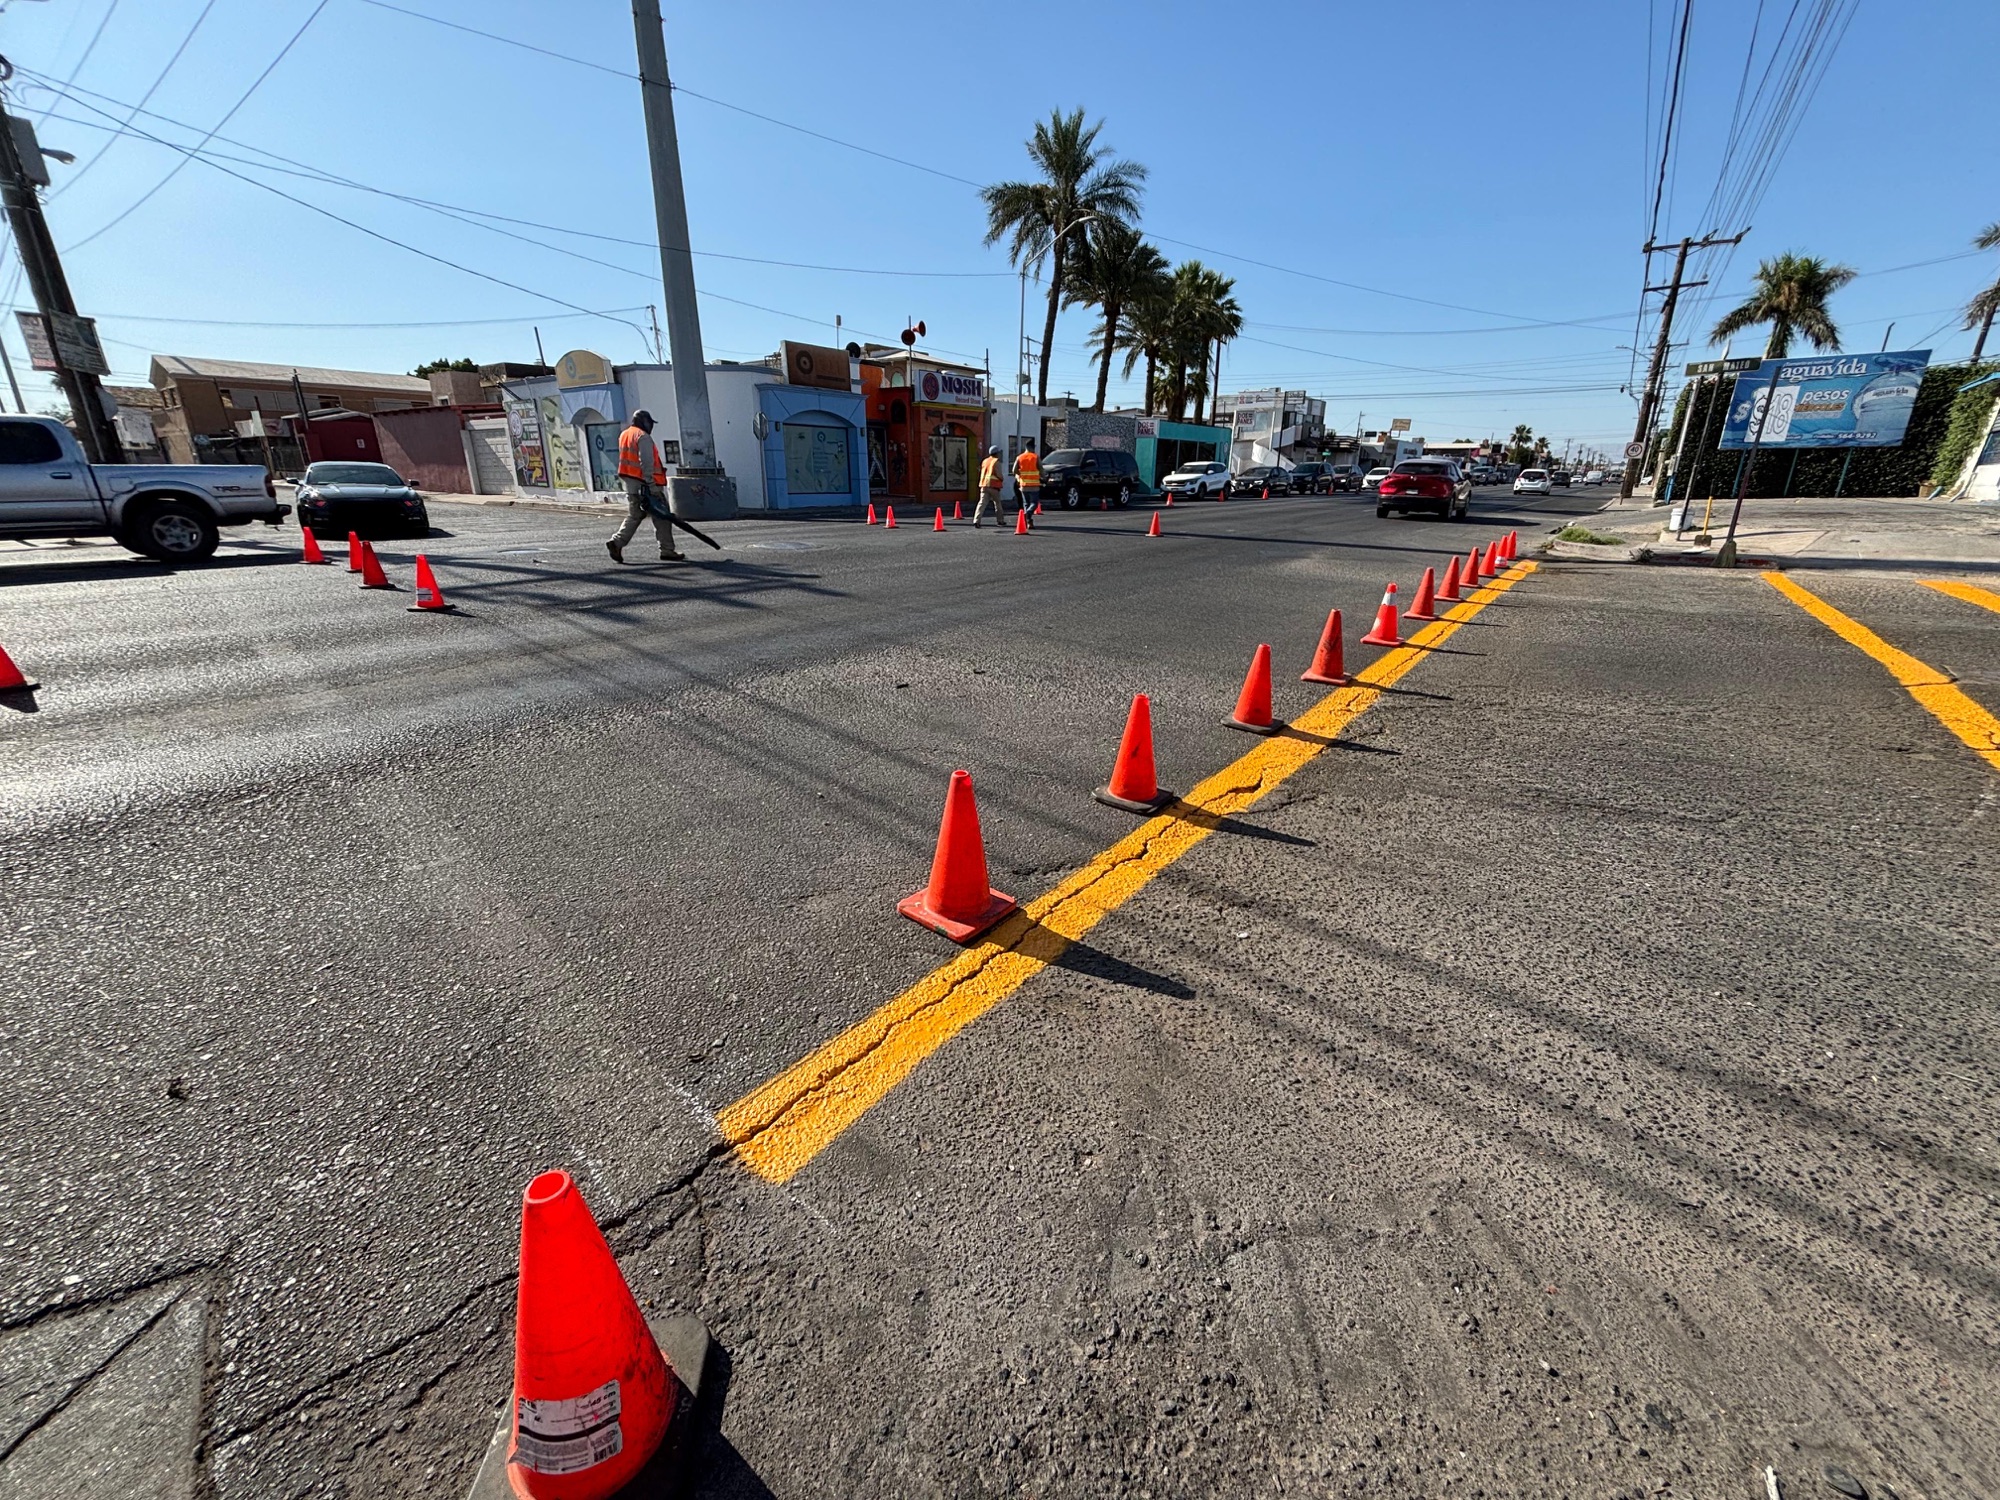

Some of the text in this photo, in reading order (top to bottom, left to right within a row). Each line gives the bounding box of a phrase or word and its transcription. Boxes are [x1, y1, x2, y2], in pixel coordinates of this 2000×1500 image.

[1697, 360, 1751, 373] SAN MATEO
[941, 375, 982, 397] MOSH
[1801, 389, 1850, 404] pesos
[603, 1391, 616, 1400] cm
